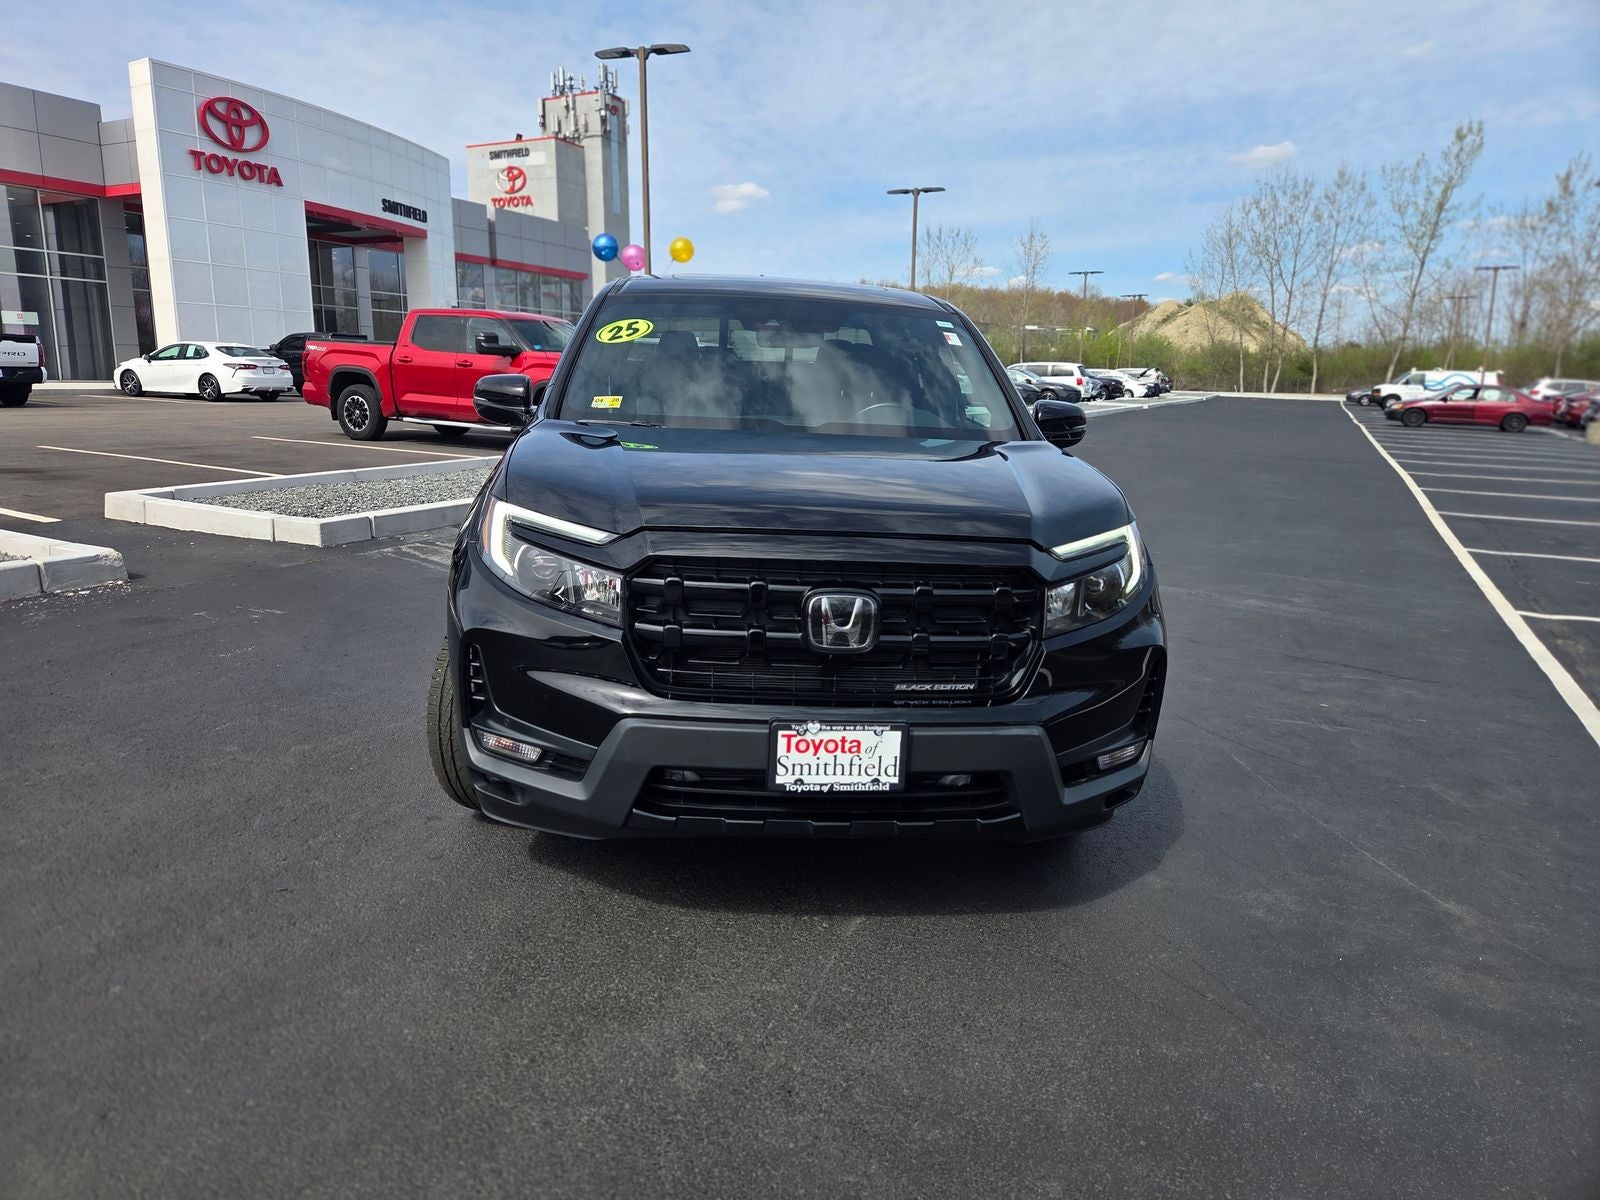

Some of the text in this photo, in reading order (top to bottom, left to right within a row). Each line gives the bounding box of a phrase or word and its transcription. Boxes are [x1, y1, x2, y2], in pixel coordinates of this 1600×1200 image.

[489, 148, 530, 160] SMITHFIELD
[188, 149, 283, 187] TOYOTA
[382, 198, 428, 223] SMITHFIELD
[491, 195, 533, 208] TOYOTA
[608, 321, 640, 341] 25
[781, 734, 882, 758] Toyota of
[776, 755, 899, 778] Smithfield
[785, 783, 890, 793] Toyota of Smithfield
